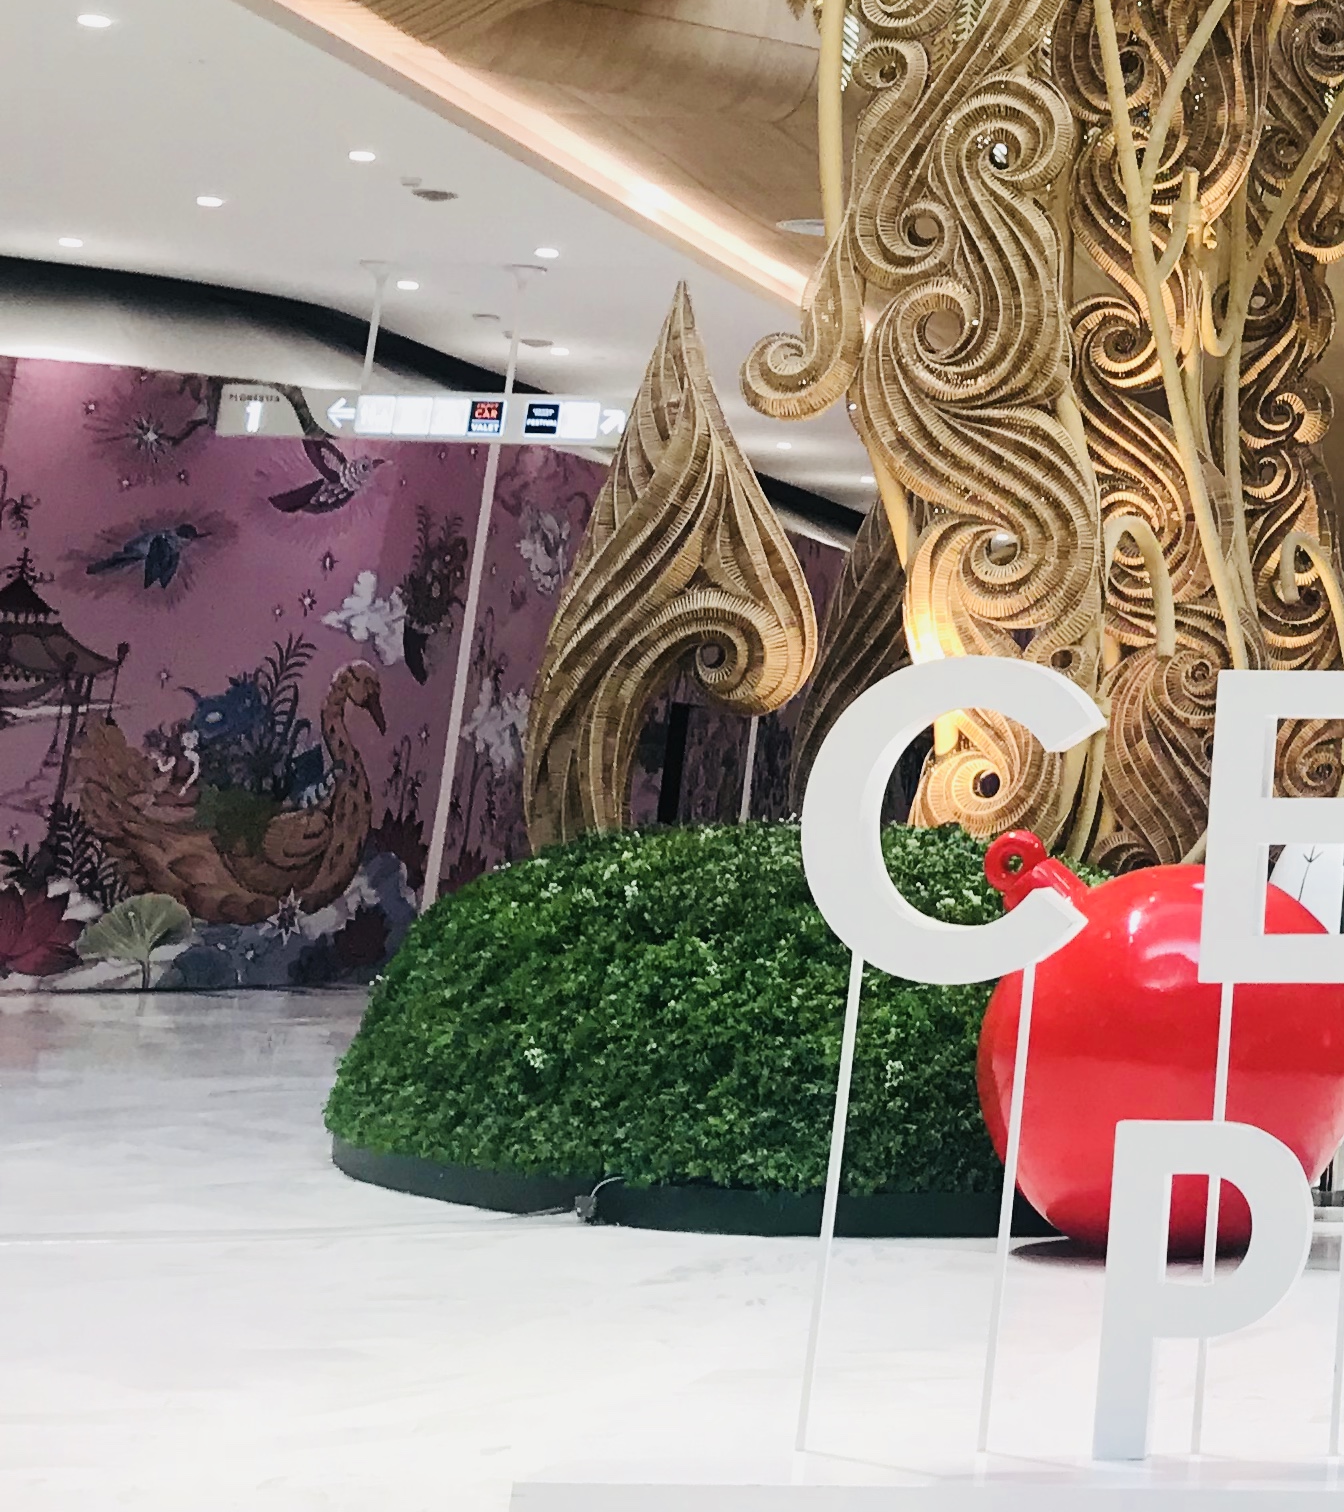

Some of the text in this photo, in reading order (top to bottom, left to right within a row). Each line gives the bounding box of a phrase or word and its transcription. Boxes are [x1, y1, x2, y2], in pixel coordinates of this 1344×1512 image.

[245, 400, 263, 433] 1
[475, 408, 498, 419] CAR
[471, 423, 499, 432] VALET
